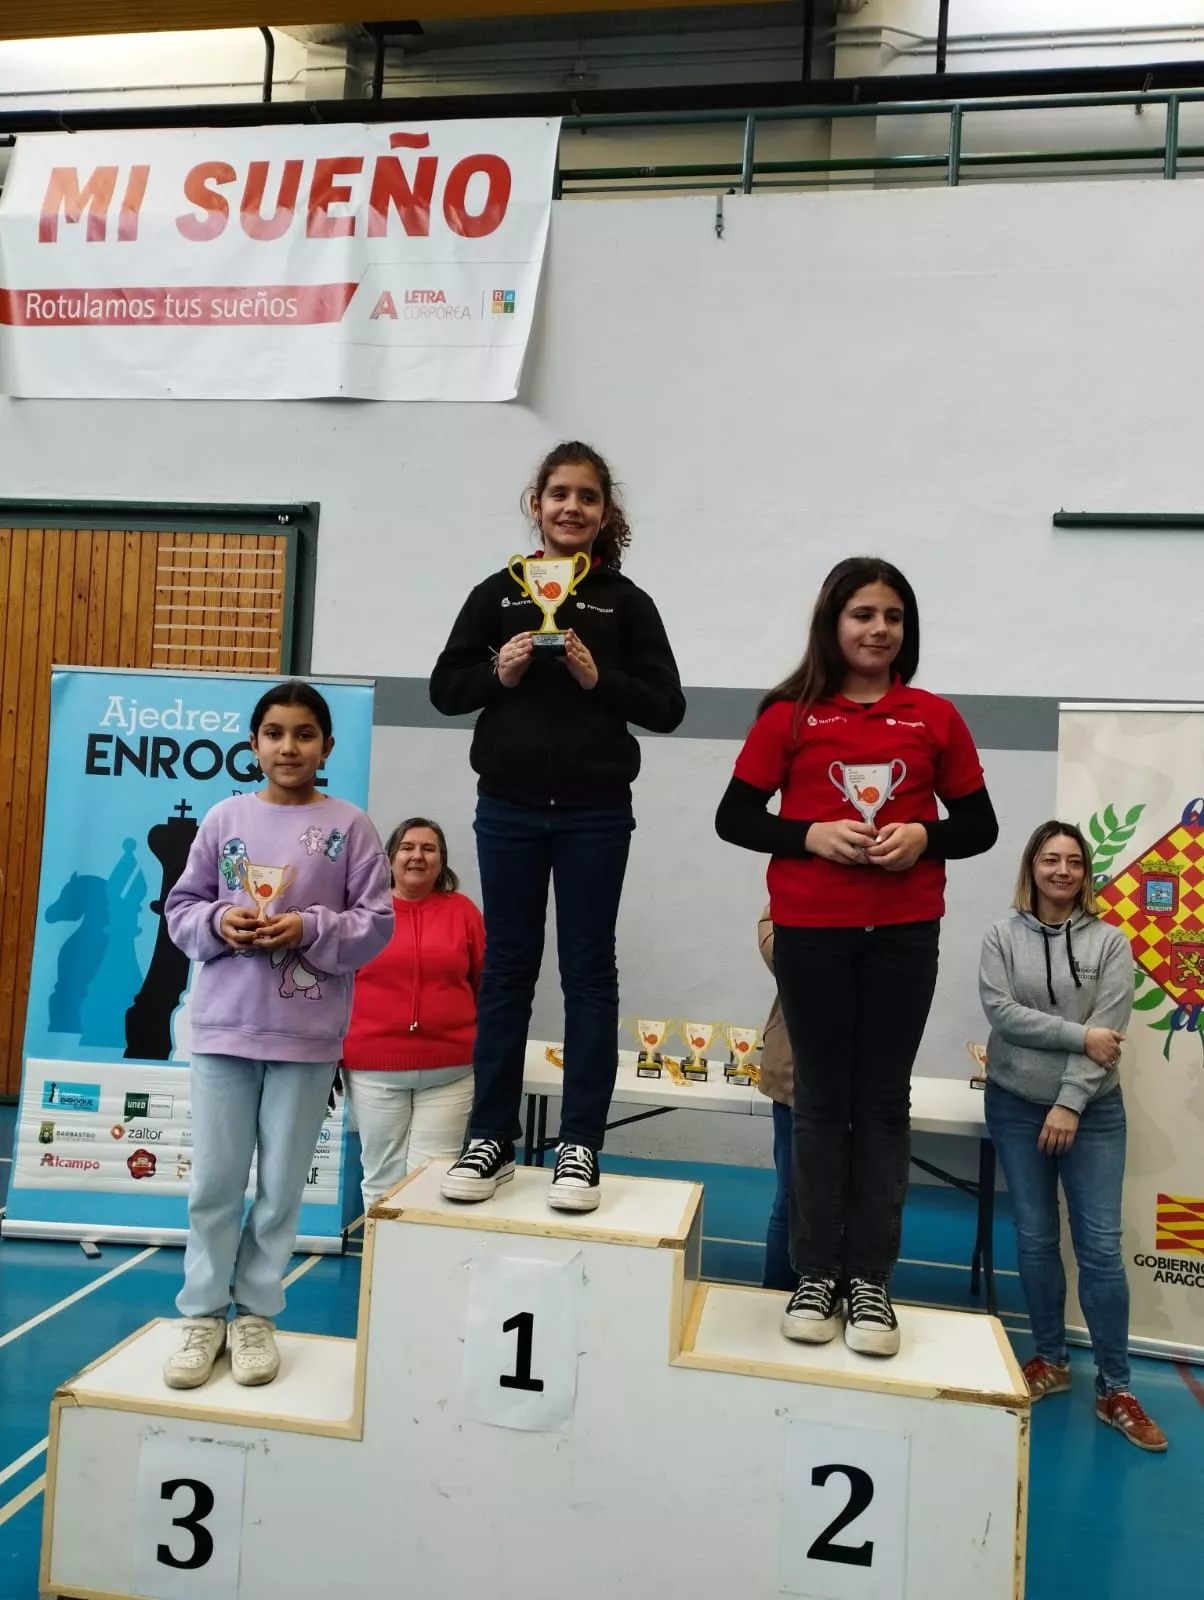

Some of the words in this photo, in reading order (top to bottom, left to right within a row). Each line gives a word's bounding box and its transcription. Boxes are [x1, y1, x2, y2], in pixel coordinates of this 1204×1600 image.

[38, 165, 151, 243] MI
[175, 132, 512, 242] SUEÑO
[25, 292, 155, 320] Rotulamos
[164, 292, 202, 318] tus
[210, 291, 298, 319] sueños
[405, 289, 446, 304] LETRA
[100, 695, 240, 736] Ajedrez
[85, 733, 328, 788] ENROQ
[127, 1127, 163, 1140] zaltor
[40, 1153, 100, 1171] Alcampo
[499, 1311, 544, 1393] 1
[156, 1478, 215, 1570] 3
[807, 1463, 875, 1567] 2
